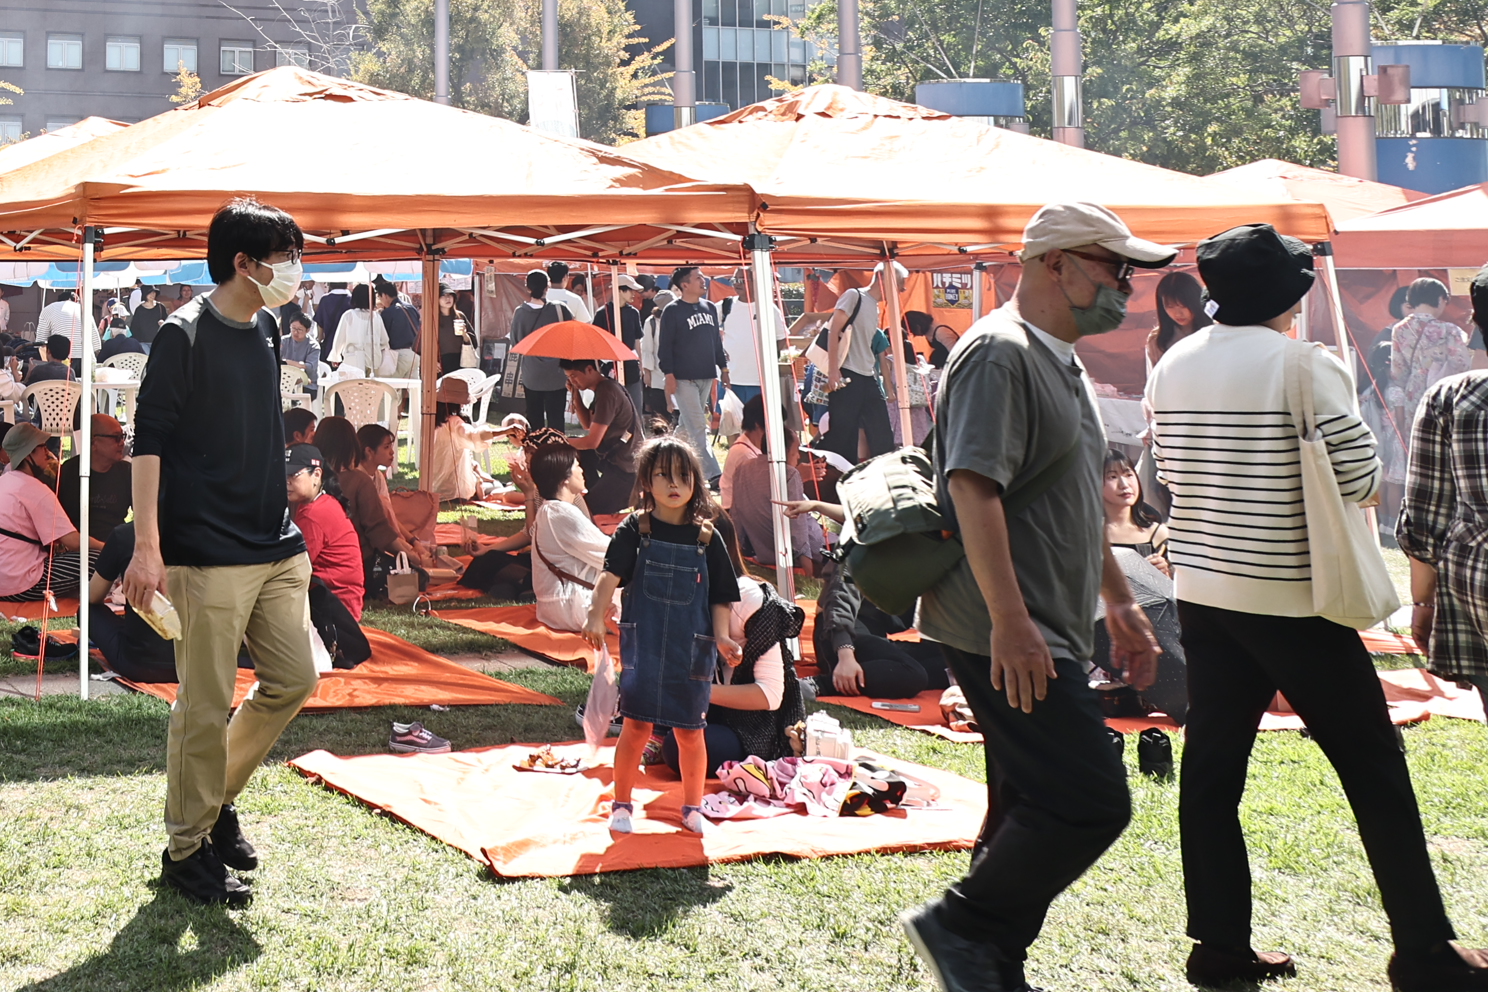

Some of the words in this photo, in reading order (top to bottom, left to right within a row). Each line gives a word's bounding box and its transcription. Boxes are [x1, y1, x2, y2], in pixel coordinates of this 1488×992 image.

[933, 273, 972, 288] ハチミツ
[687, 312, 715, 330] MIAMI
